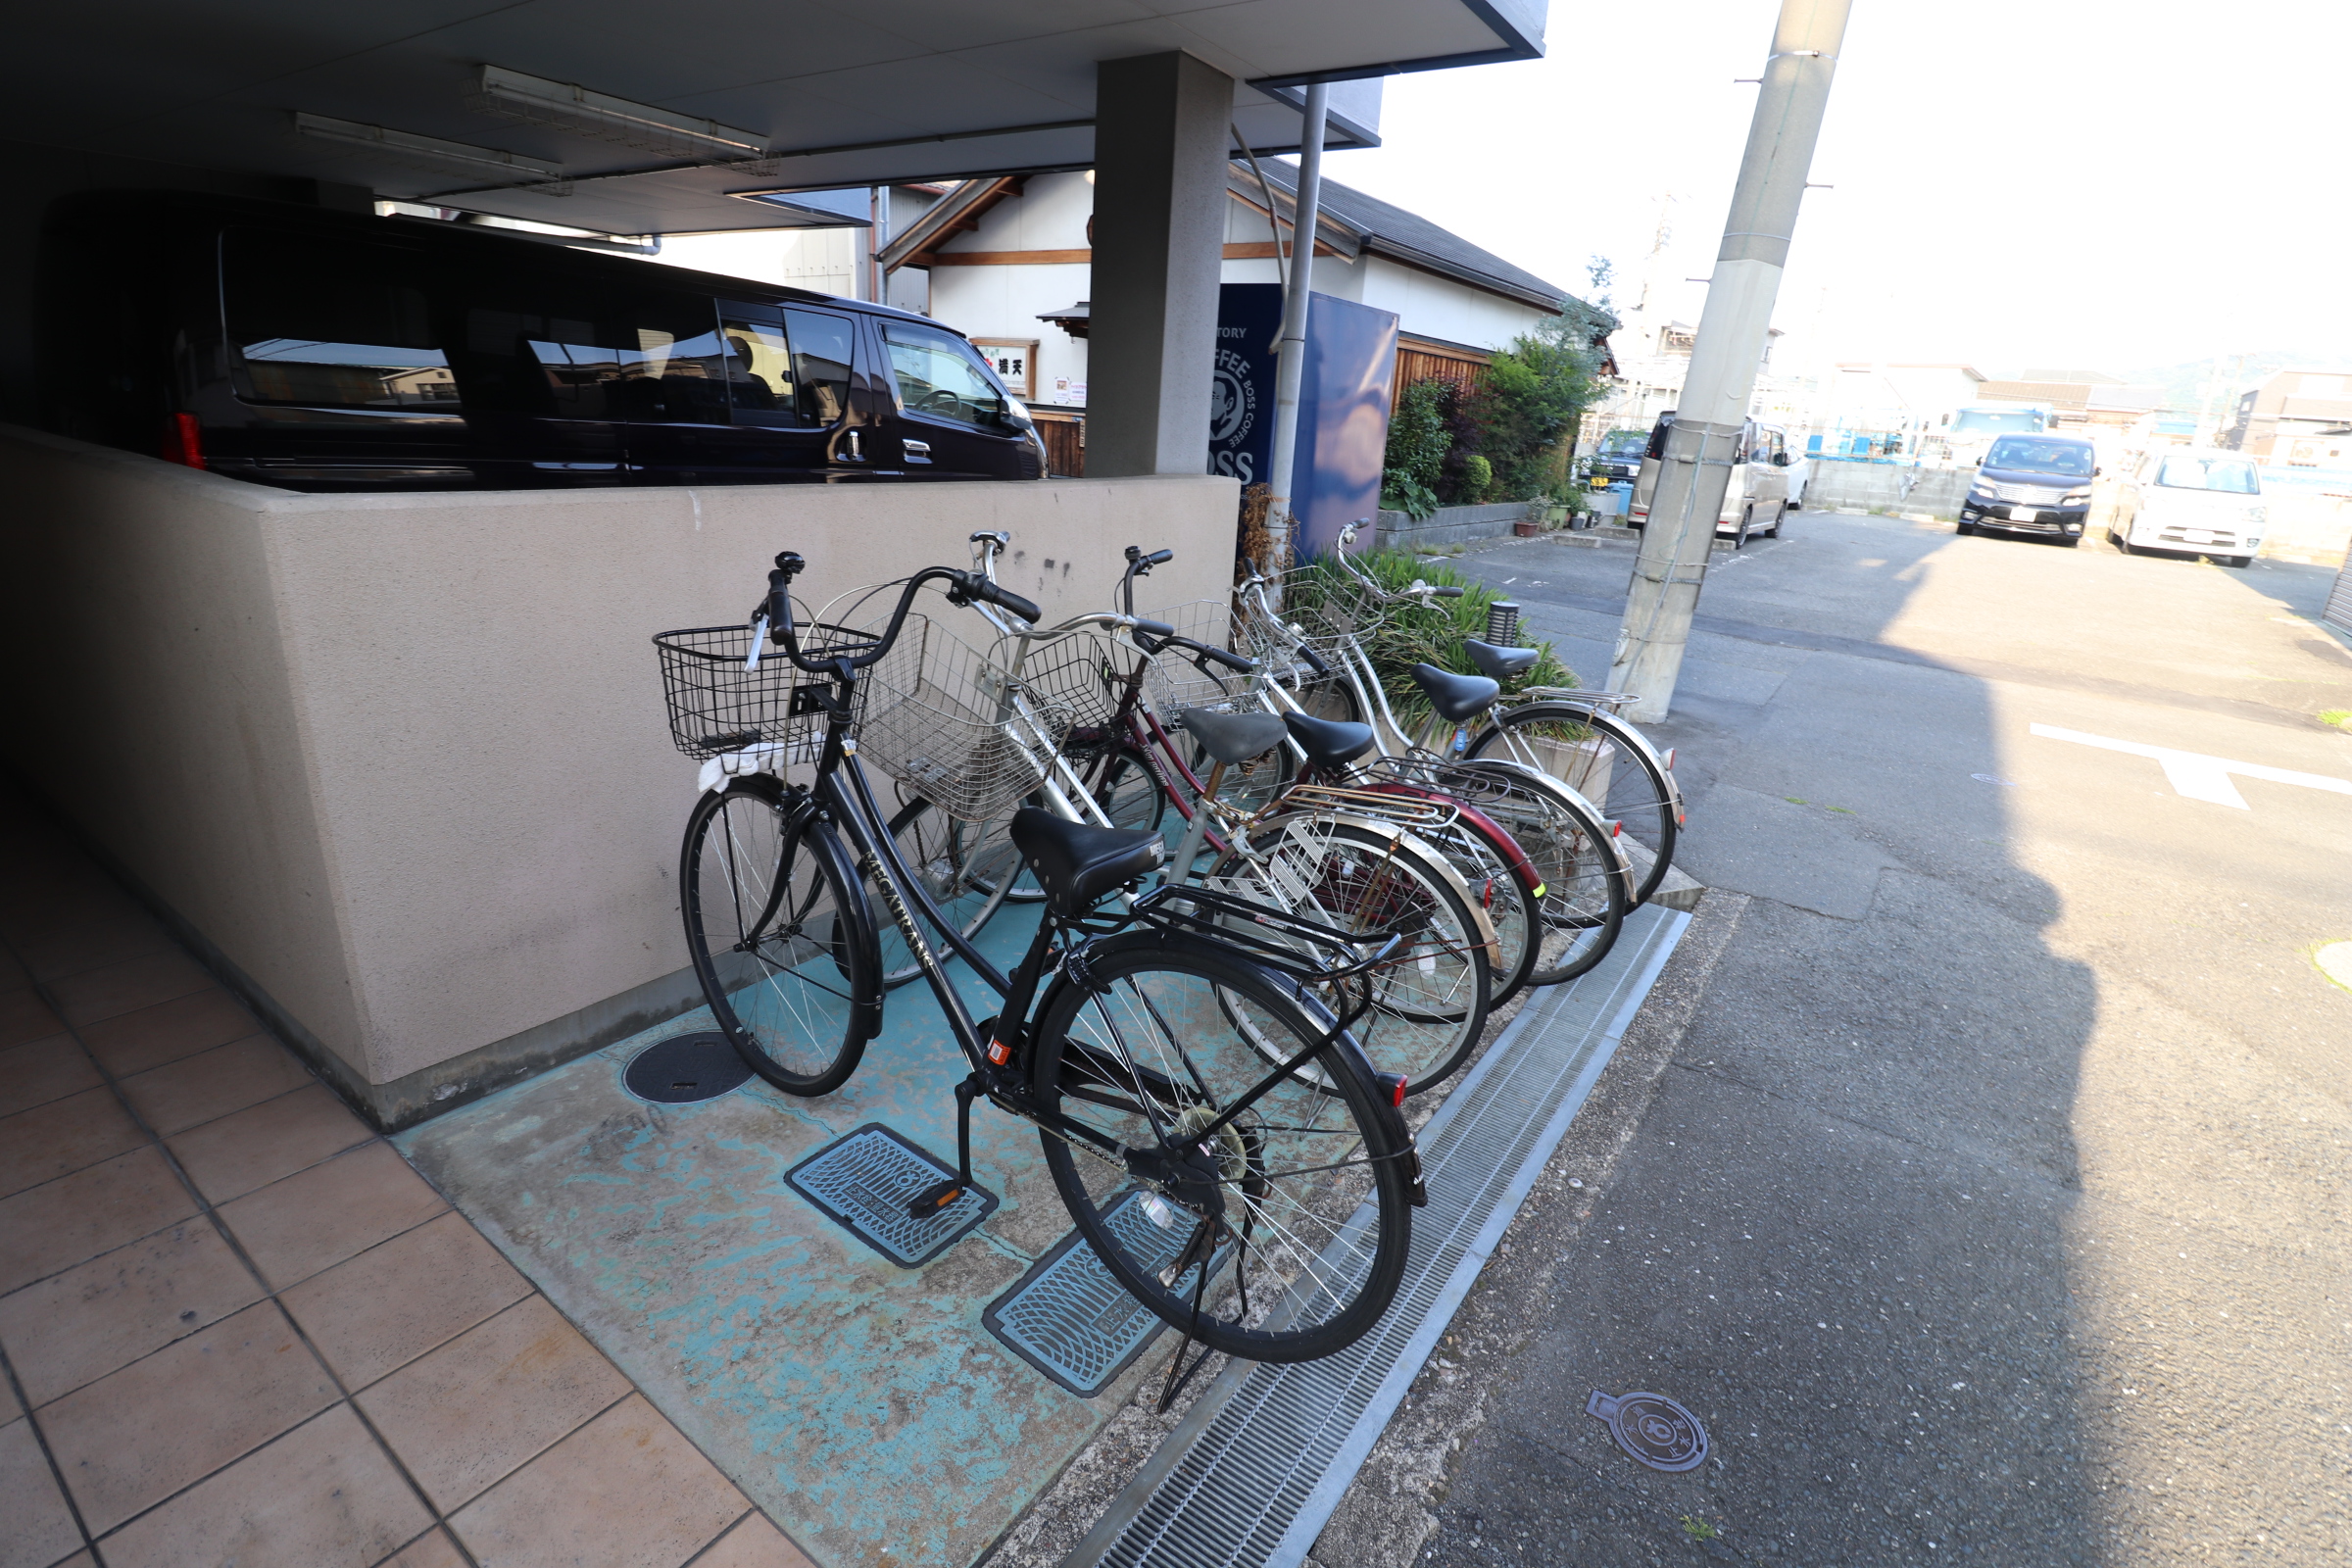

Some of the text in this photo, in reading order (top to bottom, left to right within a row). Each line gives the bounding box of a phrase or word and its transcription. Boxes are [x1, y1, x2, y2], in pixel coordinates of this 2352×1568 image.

[1228, 379, 1256, 449] BOSS COFFEE
[863, 849, 933, 969] MEGATRANS
